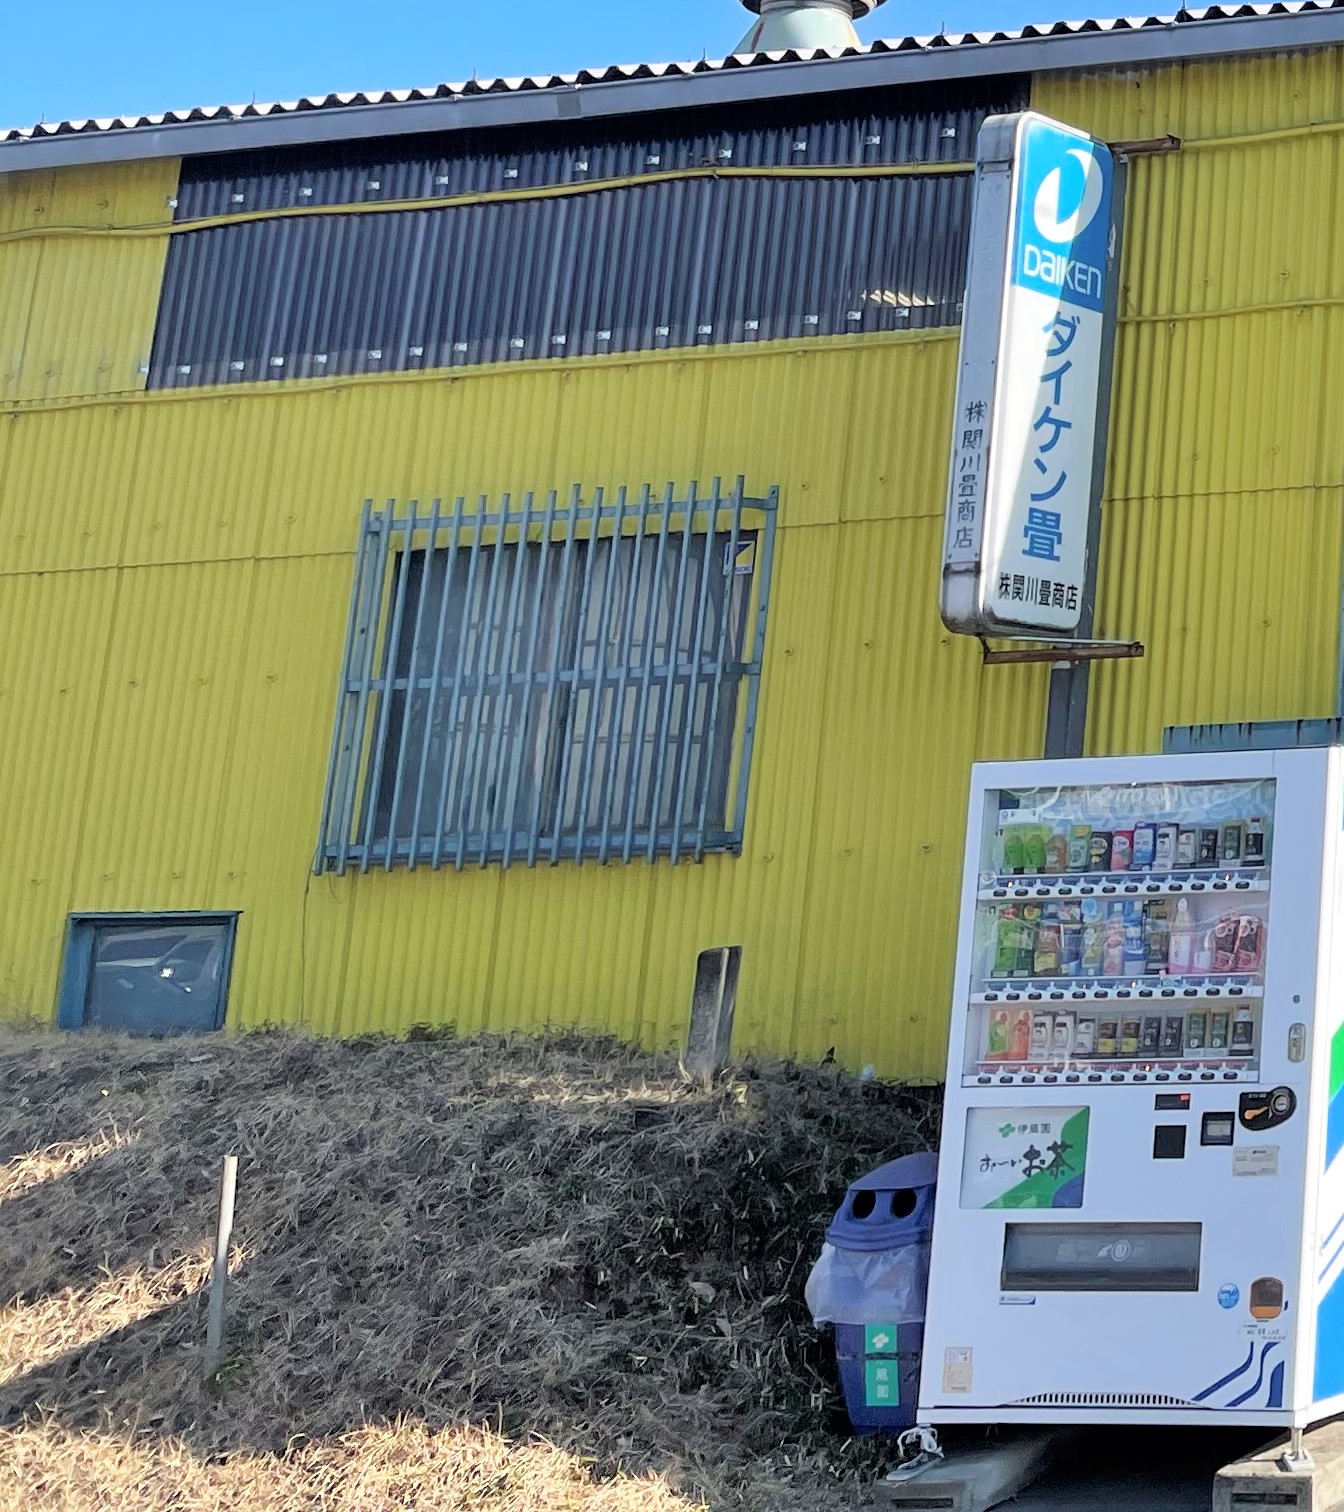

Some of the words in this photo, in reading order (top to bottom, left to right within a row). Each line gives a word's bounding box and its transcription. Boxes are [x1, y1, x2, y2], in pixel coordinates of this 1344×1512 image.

[1021, 310, 1081, 563] ダイケン畳
